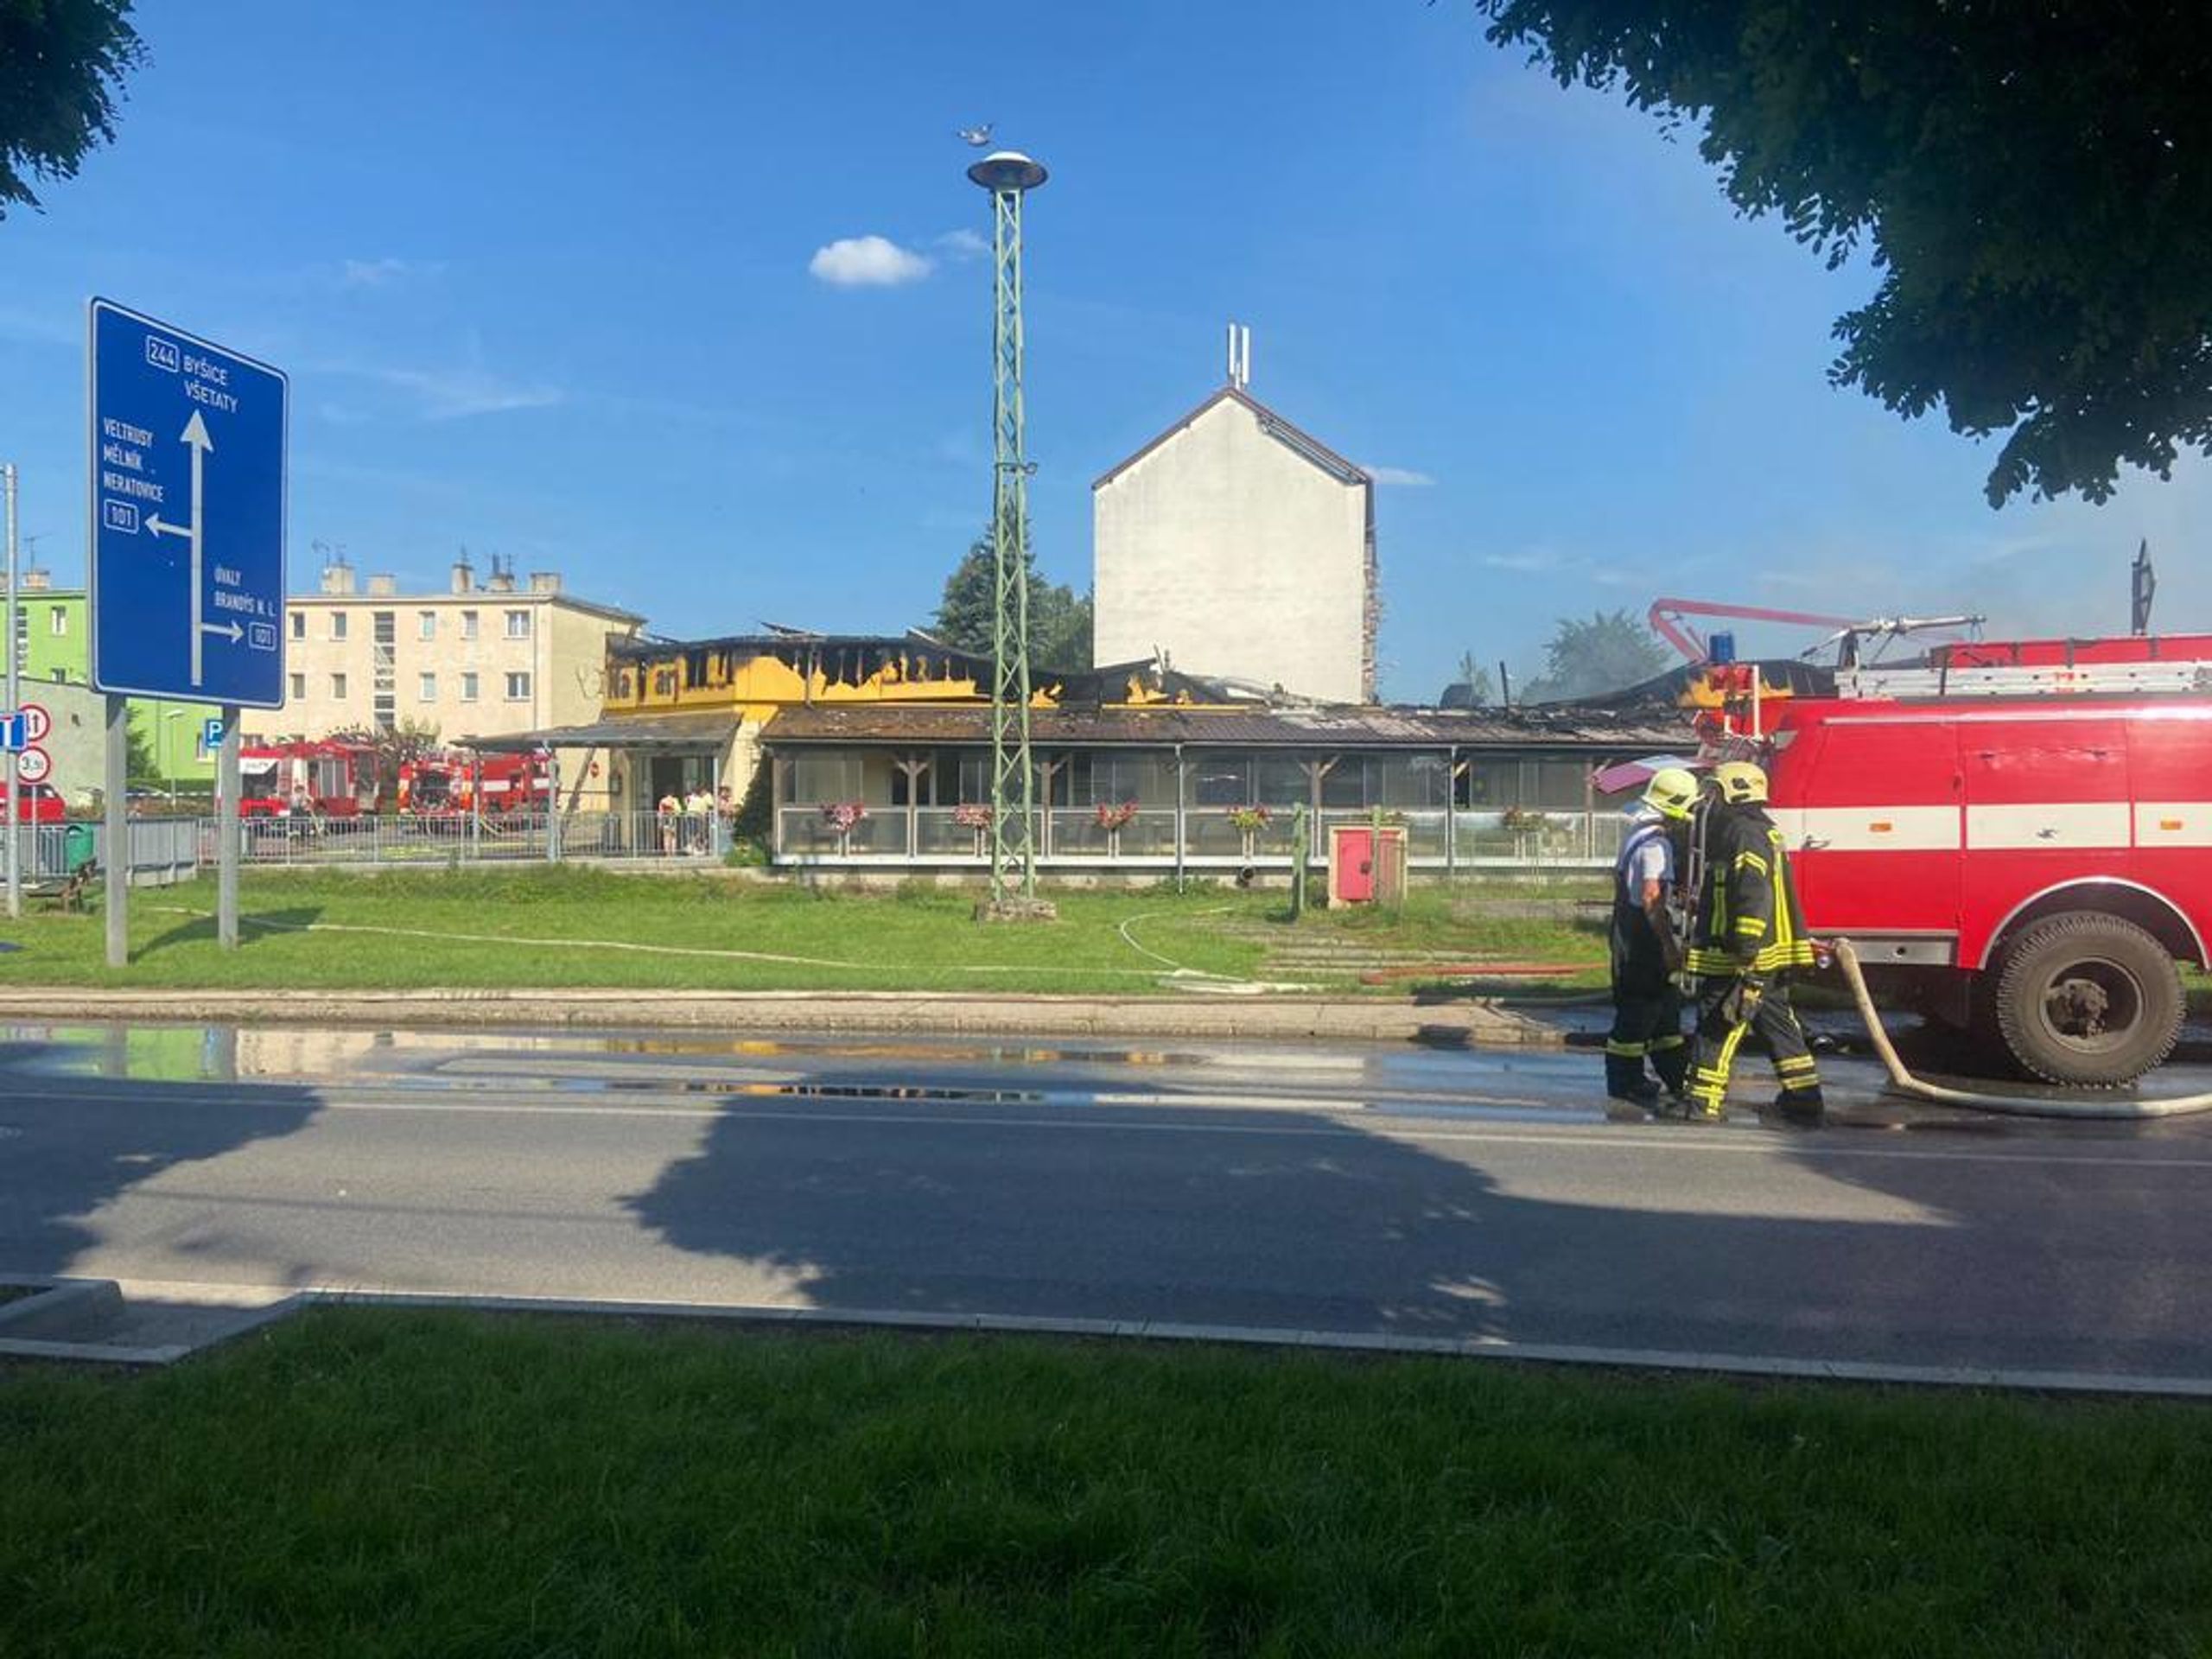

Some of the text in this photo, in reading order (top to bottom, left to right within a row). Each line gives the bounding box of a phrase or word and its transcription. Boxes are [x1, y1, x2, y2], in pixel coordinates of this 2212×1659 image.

[150, 343, 175, 366] 244
[183, 354, 228, 385] BYŠICE
[184, 379, 238, 414] VŠETATY
[103, 471, 163, 502] NERATOVICE
[111, 505, 132, 526] 101
[214, 589, 254, 613] BRANDÝS
[209, 721, 222, 741] P
